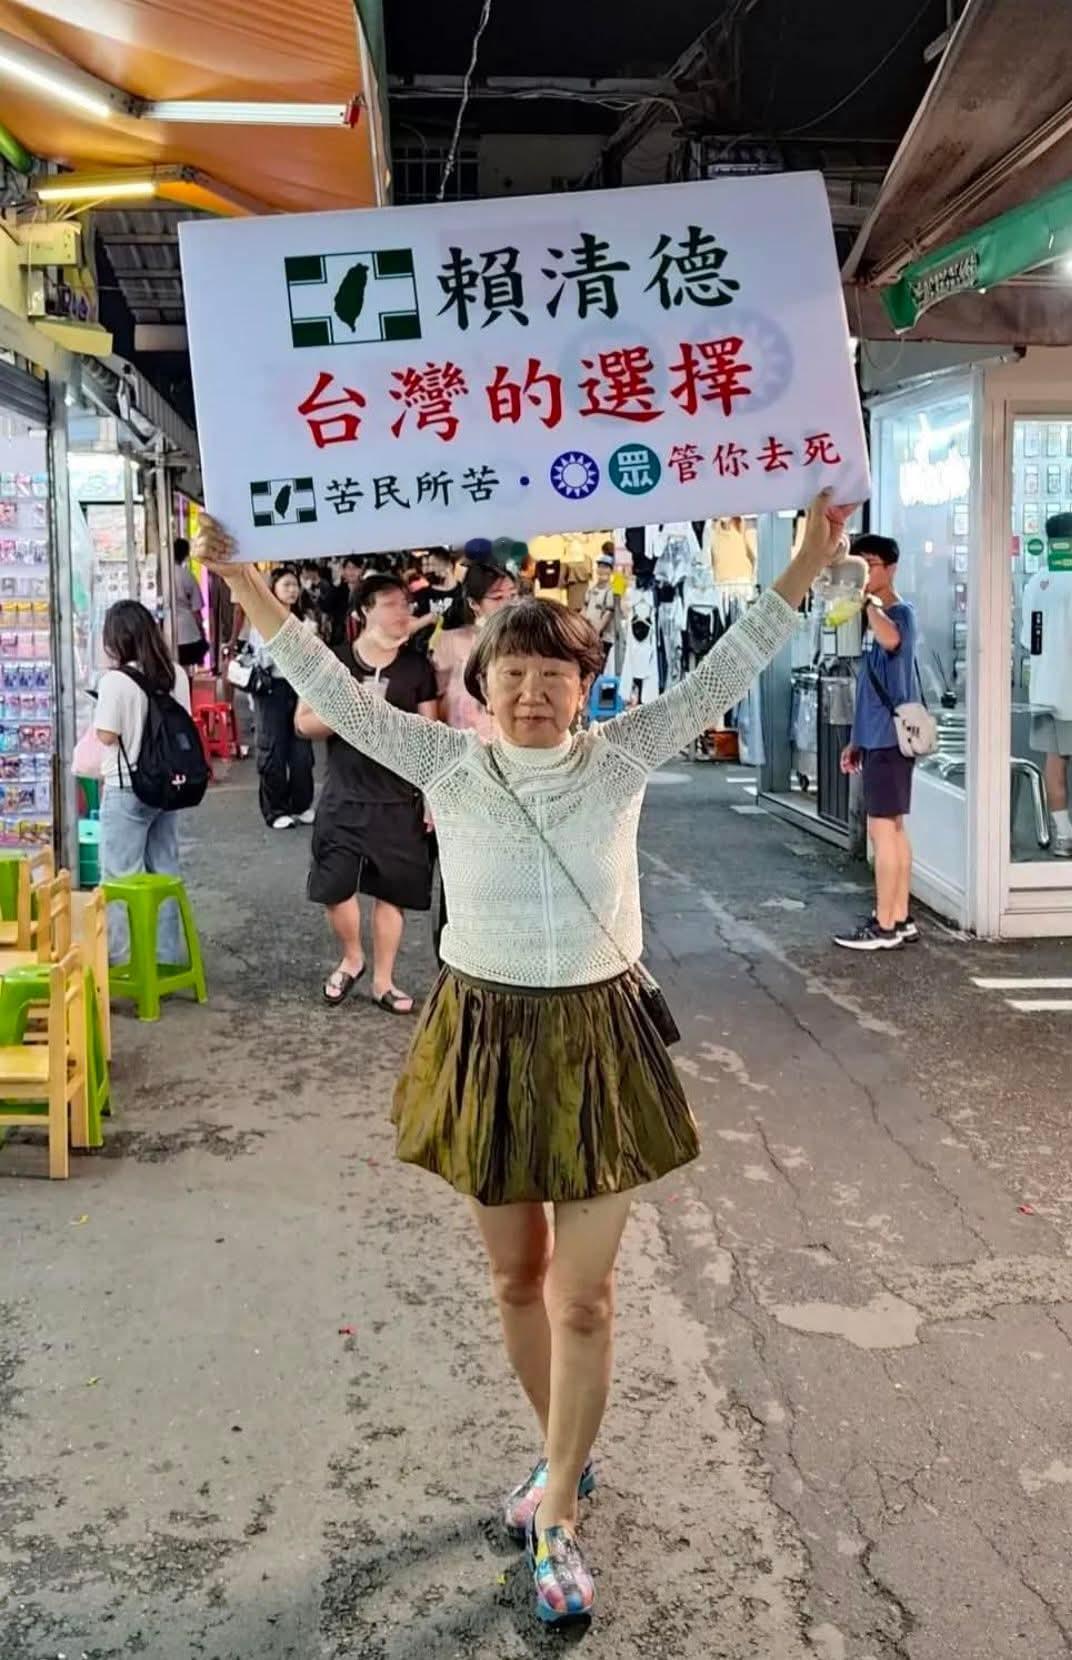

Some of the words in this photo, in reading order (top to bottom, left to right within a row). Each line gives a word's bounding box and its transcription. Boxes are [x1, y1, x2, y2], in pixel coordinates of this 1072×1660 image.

[436, 224, 741, 331] 賴清德
[298, 336, 753, 449] 台灣的選擇
[616, 453, 654, 488] 眾
[669, 433, 841, 484] 管你去死
